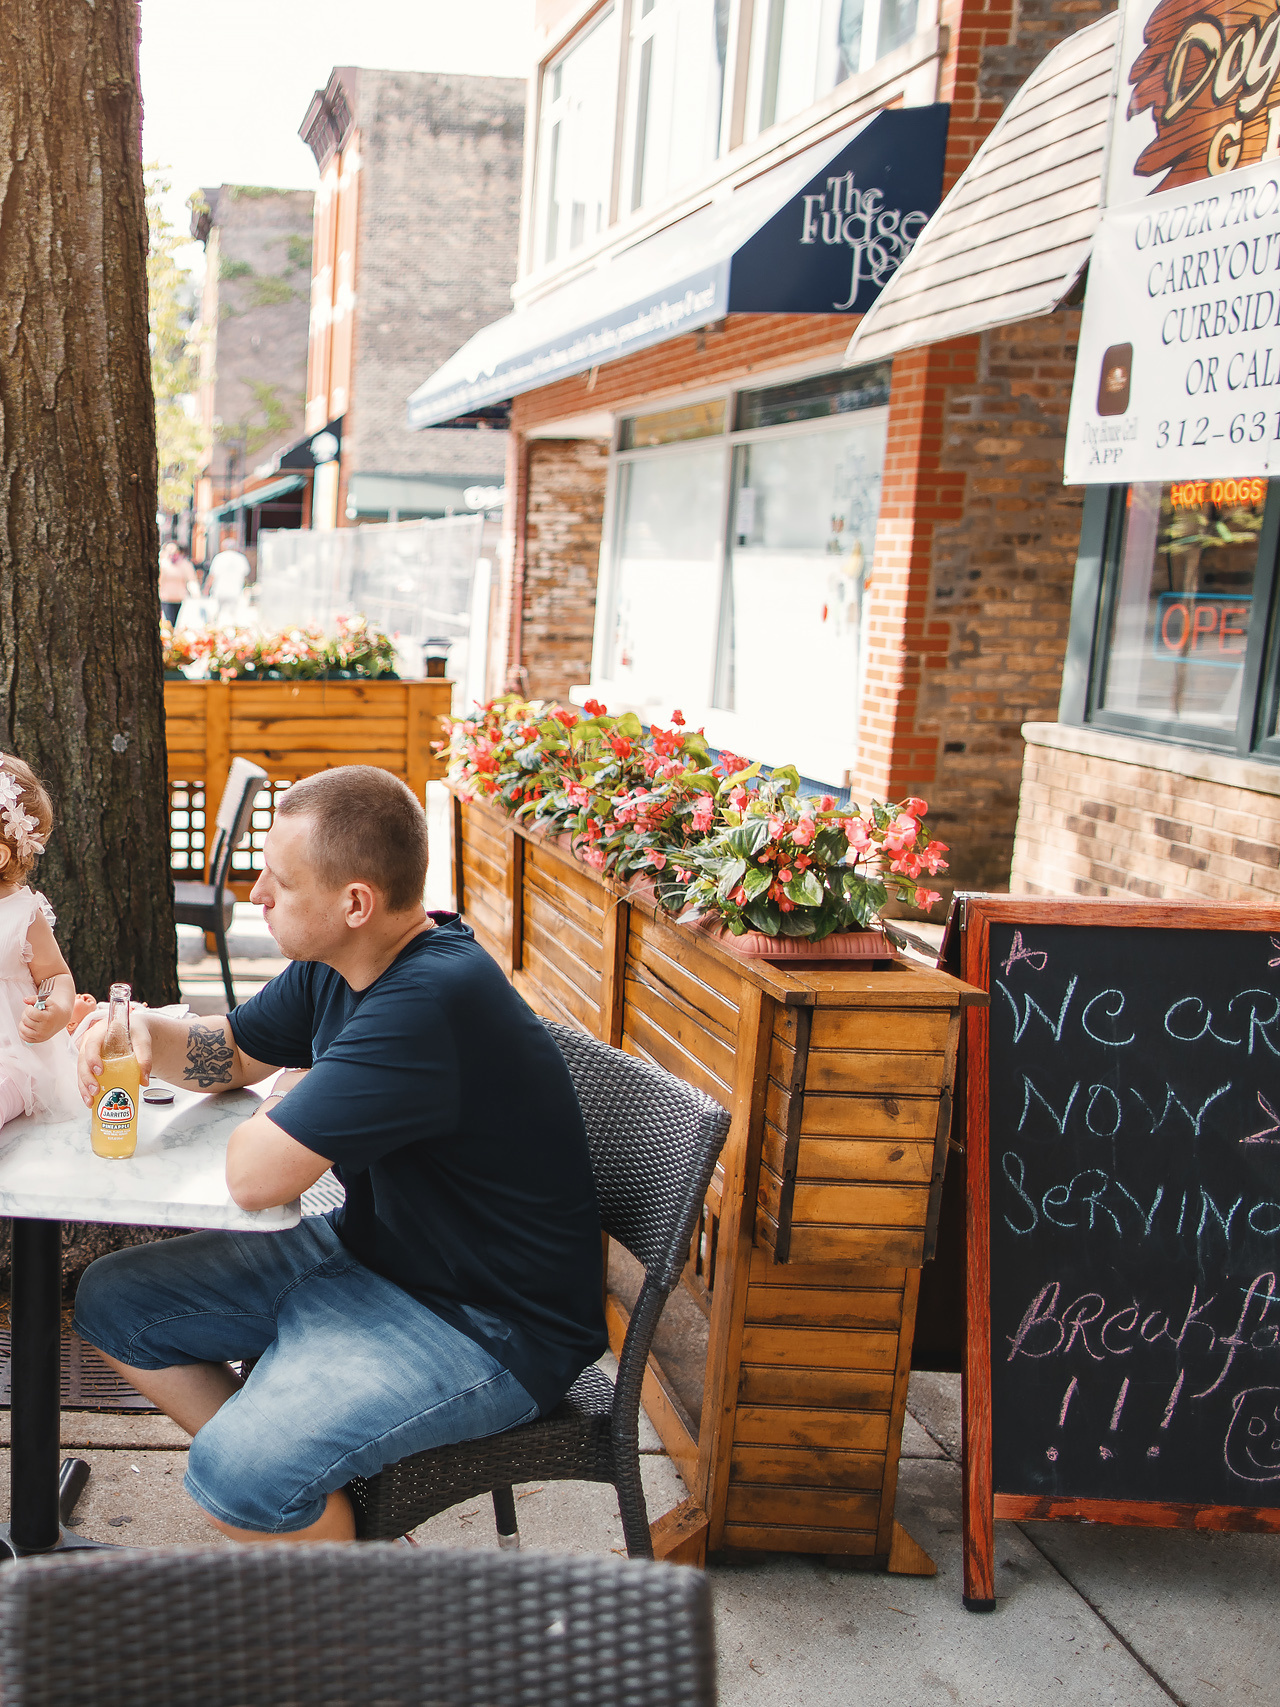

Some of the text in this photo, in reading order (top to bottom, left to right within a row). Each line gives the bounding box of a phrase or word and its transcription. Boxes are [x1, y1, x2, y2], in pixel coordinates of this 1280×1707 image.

[826, 170, 885, 214] The
[799, 194, 929, 270] Fudge
[1135, 179, 1280, 251] ORDER FRO
[1185, 358, 1218, 396] OR
[1089, 447, 1124, 464] APP
[1171, 478, 1267, 507] HOT DOGS
